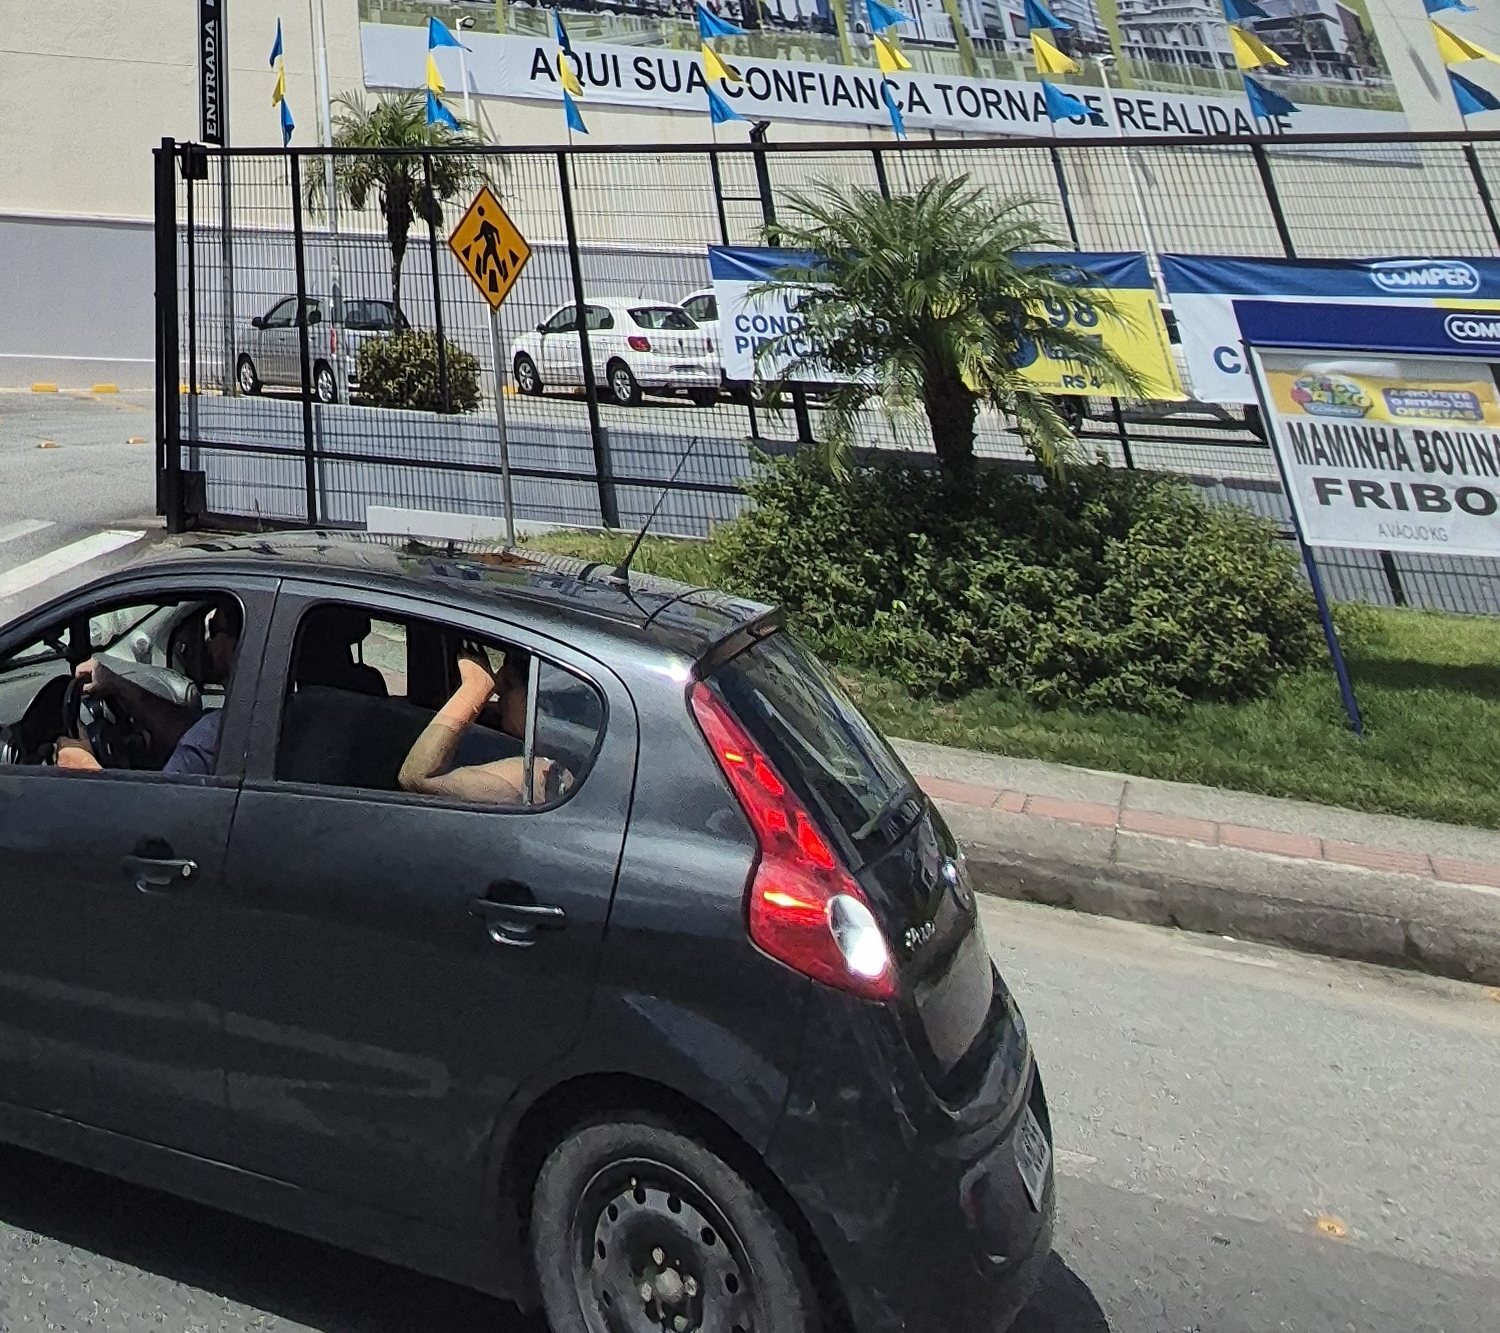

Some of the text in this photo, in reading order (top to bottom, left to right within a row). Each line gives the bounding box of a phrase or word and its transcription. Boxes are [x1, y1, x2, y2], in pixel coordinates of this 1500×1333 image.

[204, 19, 217, 136] ENTRADA
[530, 47, 622, 88] AQUI
[633, 56, 707, 94] SUA
[720, 64, 931, 117] CONFIANÇA
[1377, 268, 1474, 286] COMPER
[1452, 320, 1500, 338] COM
[1286, 422, 1416, 472] MAMINHA
[1312, 477, 1498, 516] FRIBO
